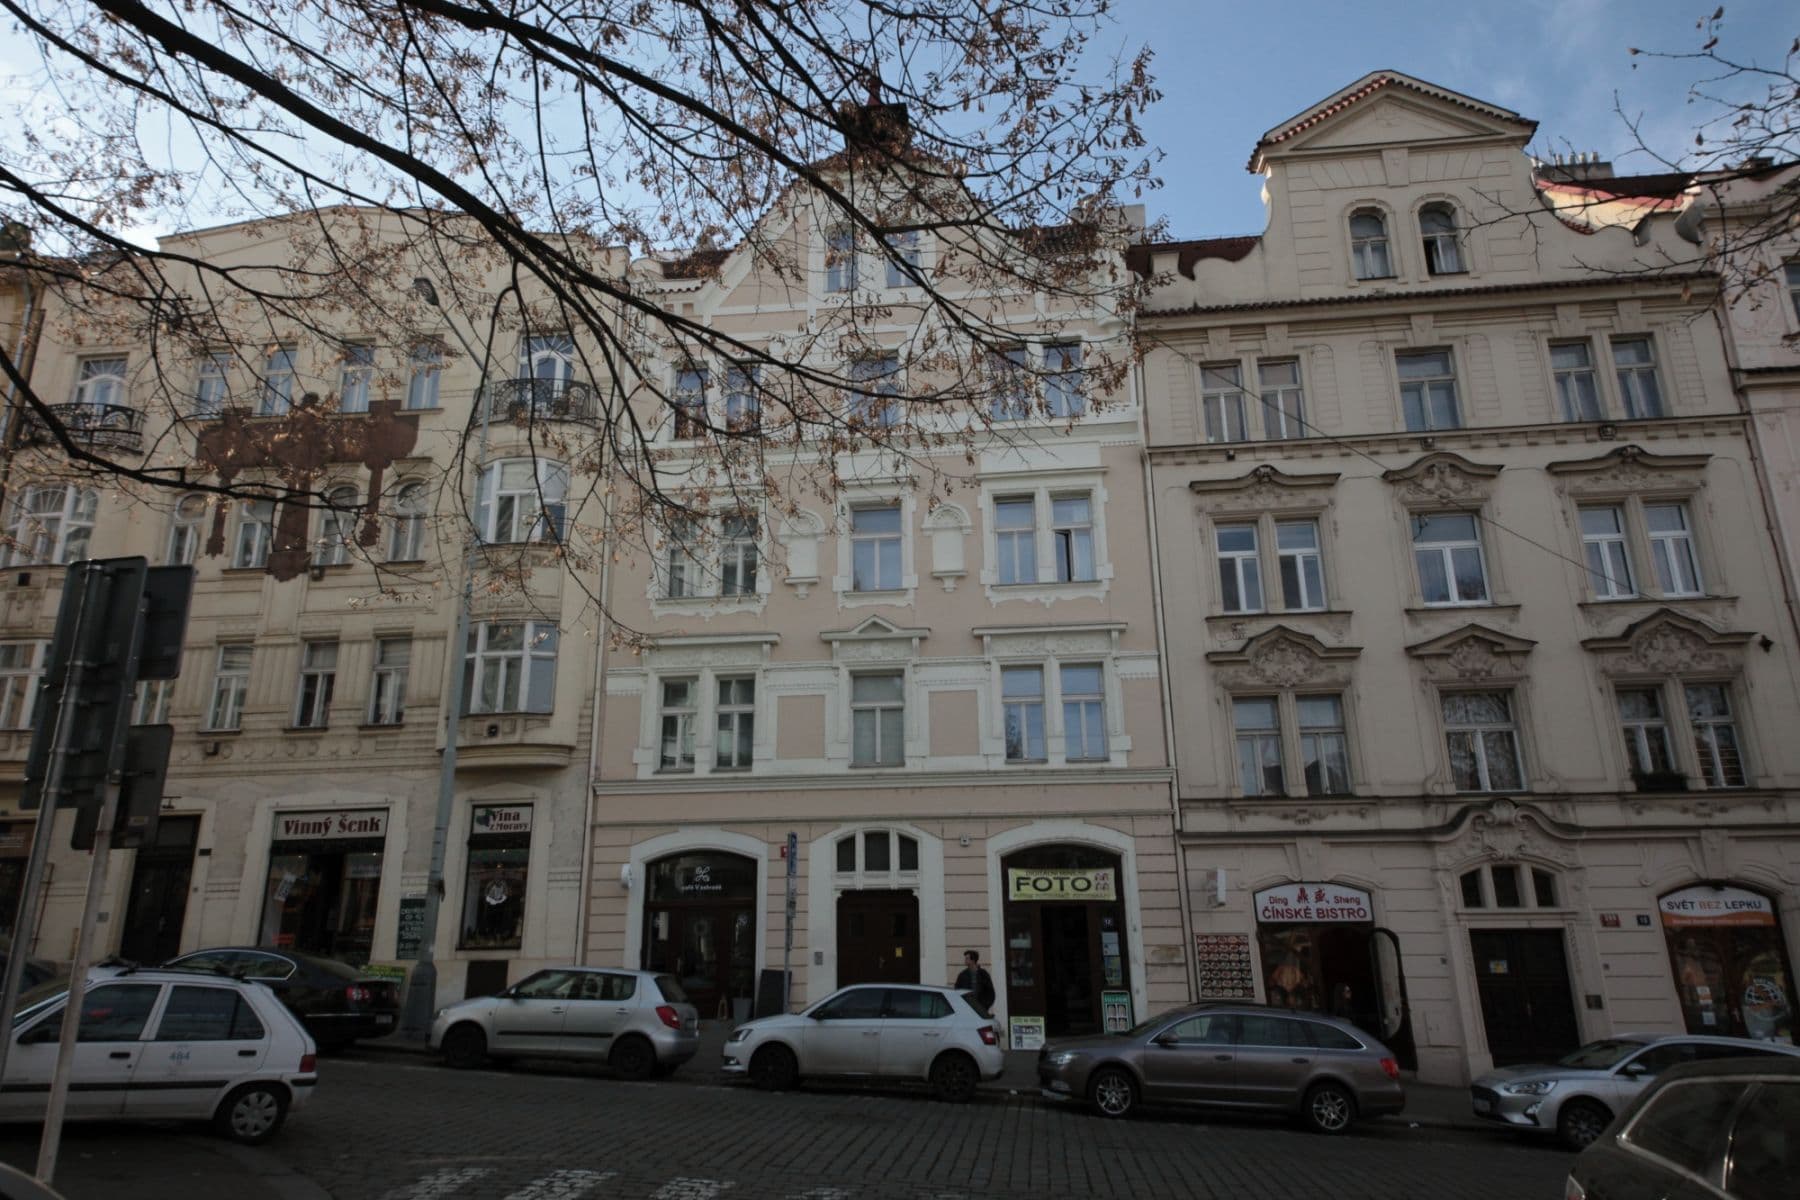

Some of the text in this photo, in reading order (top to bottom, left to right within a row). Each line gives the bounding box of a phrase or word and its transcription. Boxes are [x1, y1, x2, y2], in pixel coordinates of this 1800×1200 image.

[284, 814, 381, 837] Vinný Šenk
[1016, 877, 1092, 892] FOTO
[1268, 895, 1361, 906] Ding Sheng
[1666, 900, 1762, 910] SVĚT BEZ LEPKU
[1262, 906, 1367, 919] ČÍNSKÉ BISTRO
